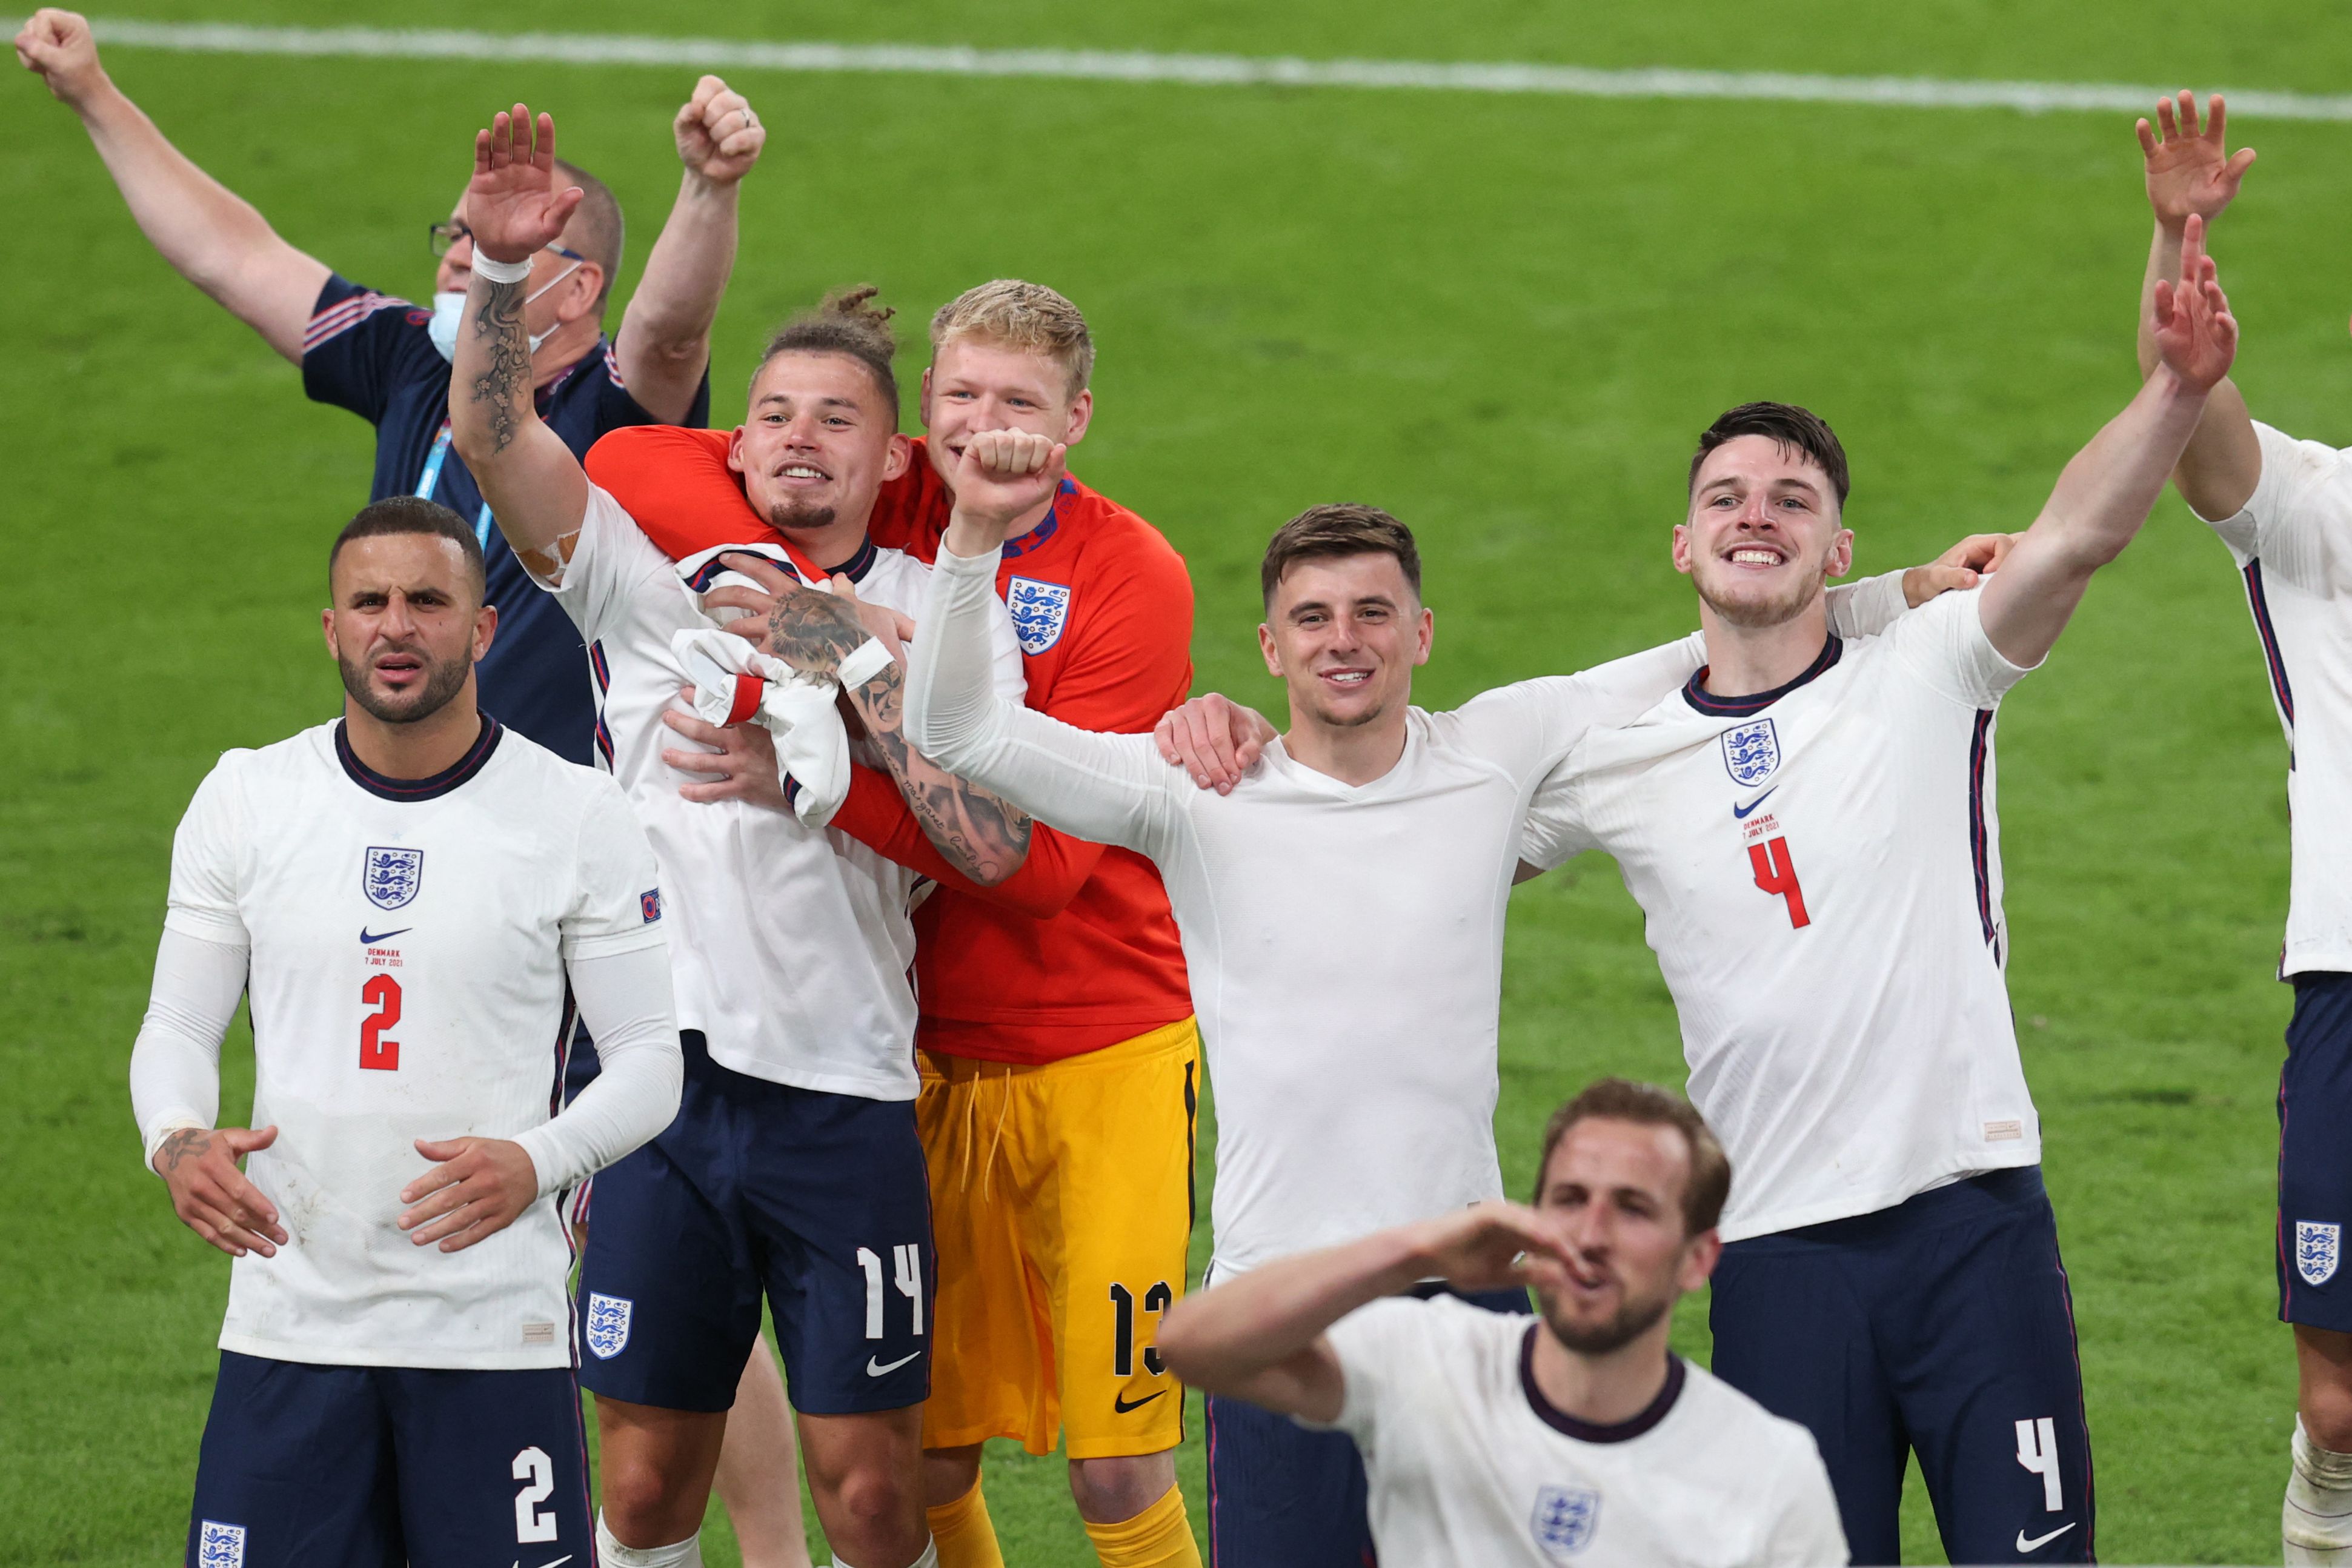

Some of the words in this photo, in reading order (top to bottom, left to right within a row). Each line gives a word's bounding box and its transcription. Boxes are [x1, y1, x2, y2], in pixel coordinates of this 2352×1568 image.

[1744, 813, 1774, 830] DENMARK
[1749, 826, 1762, 837] JULY
[1766, 821, 1779, 832] 2021
[1747, 836, 1811, 929] 4
[368, 948, 400, 957] DENMARK
[370, 957, 386, 966] JULY
[389, 958, 403, 967] 2021
[359, 974, 402, 1071] 2
[857, 1243, 923, 1339] 14
[512, 1446, 557, 1543] 2
[2015, 1417, 2063, 1512] 4
